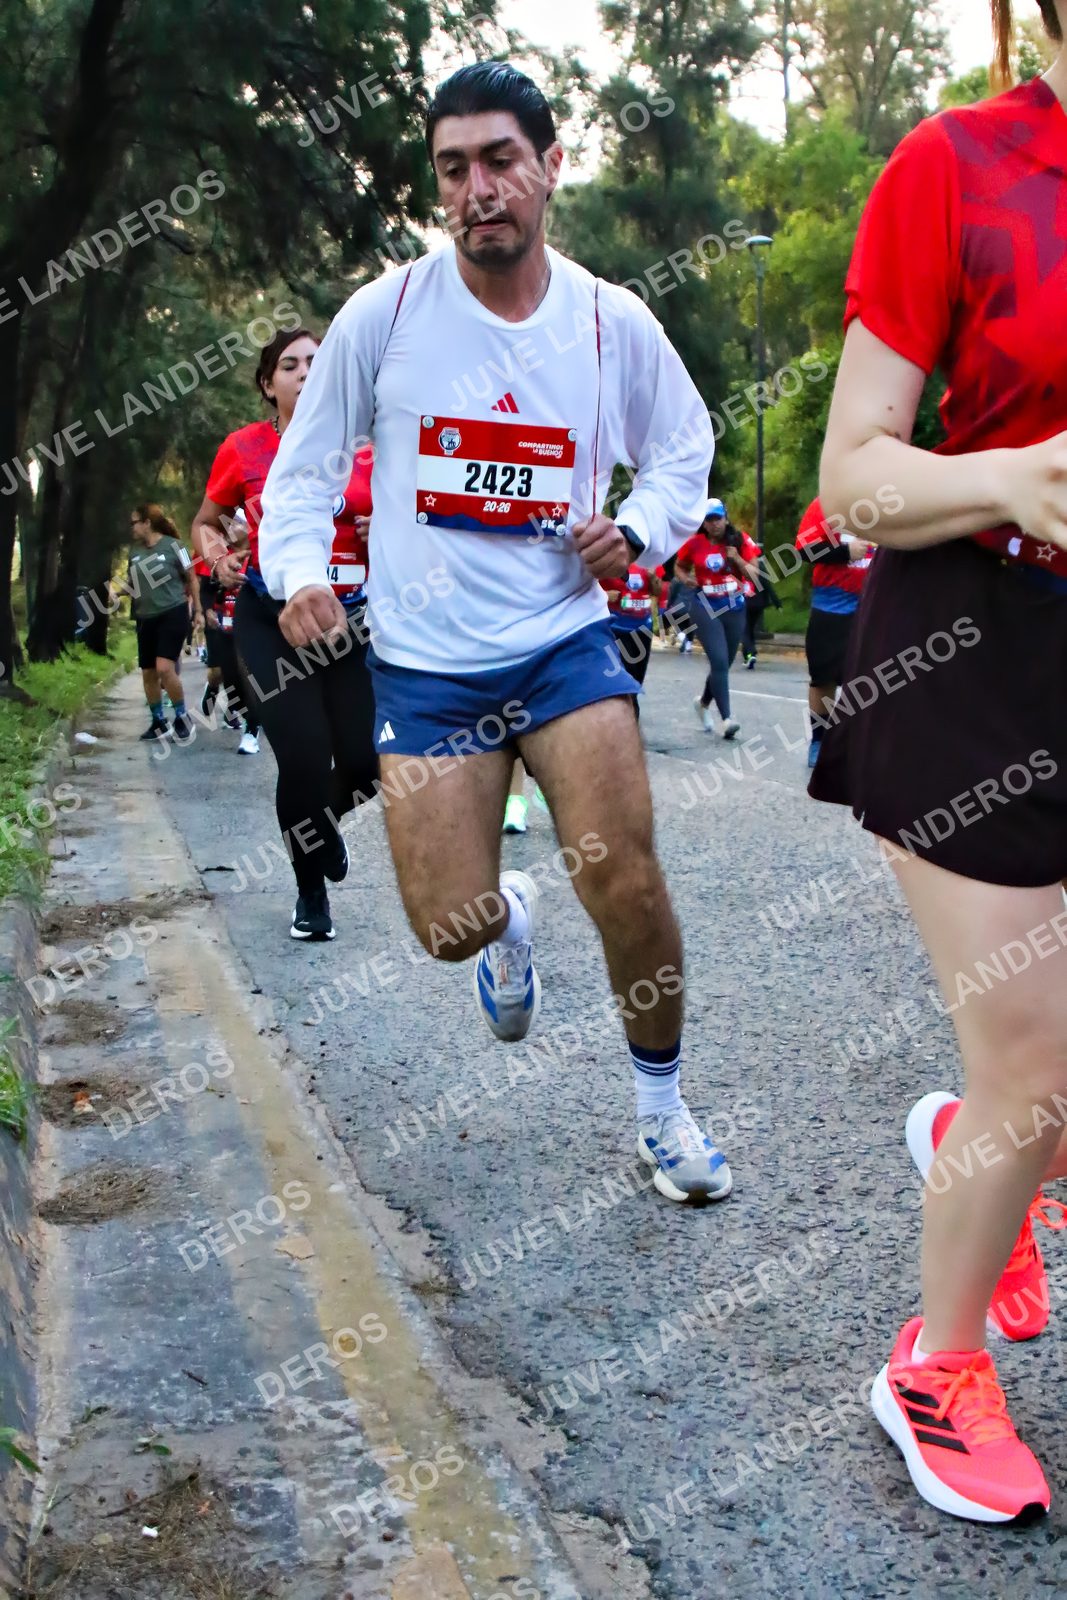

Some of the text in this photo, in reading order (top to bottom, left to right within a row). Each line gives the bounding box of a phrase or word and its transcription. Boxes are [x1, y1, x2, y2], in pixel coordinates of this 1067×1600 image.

[518, 440, 564, 451] COMPARTIMOS
[464, 462, 533, 497] 2423
[541, 519, 556, 529] 5K
